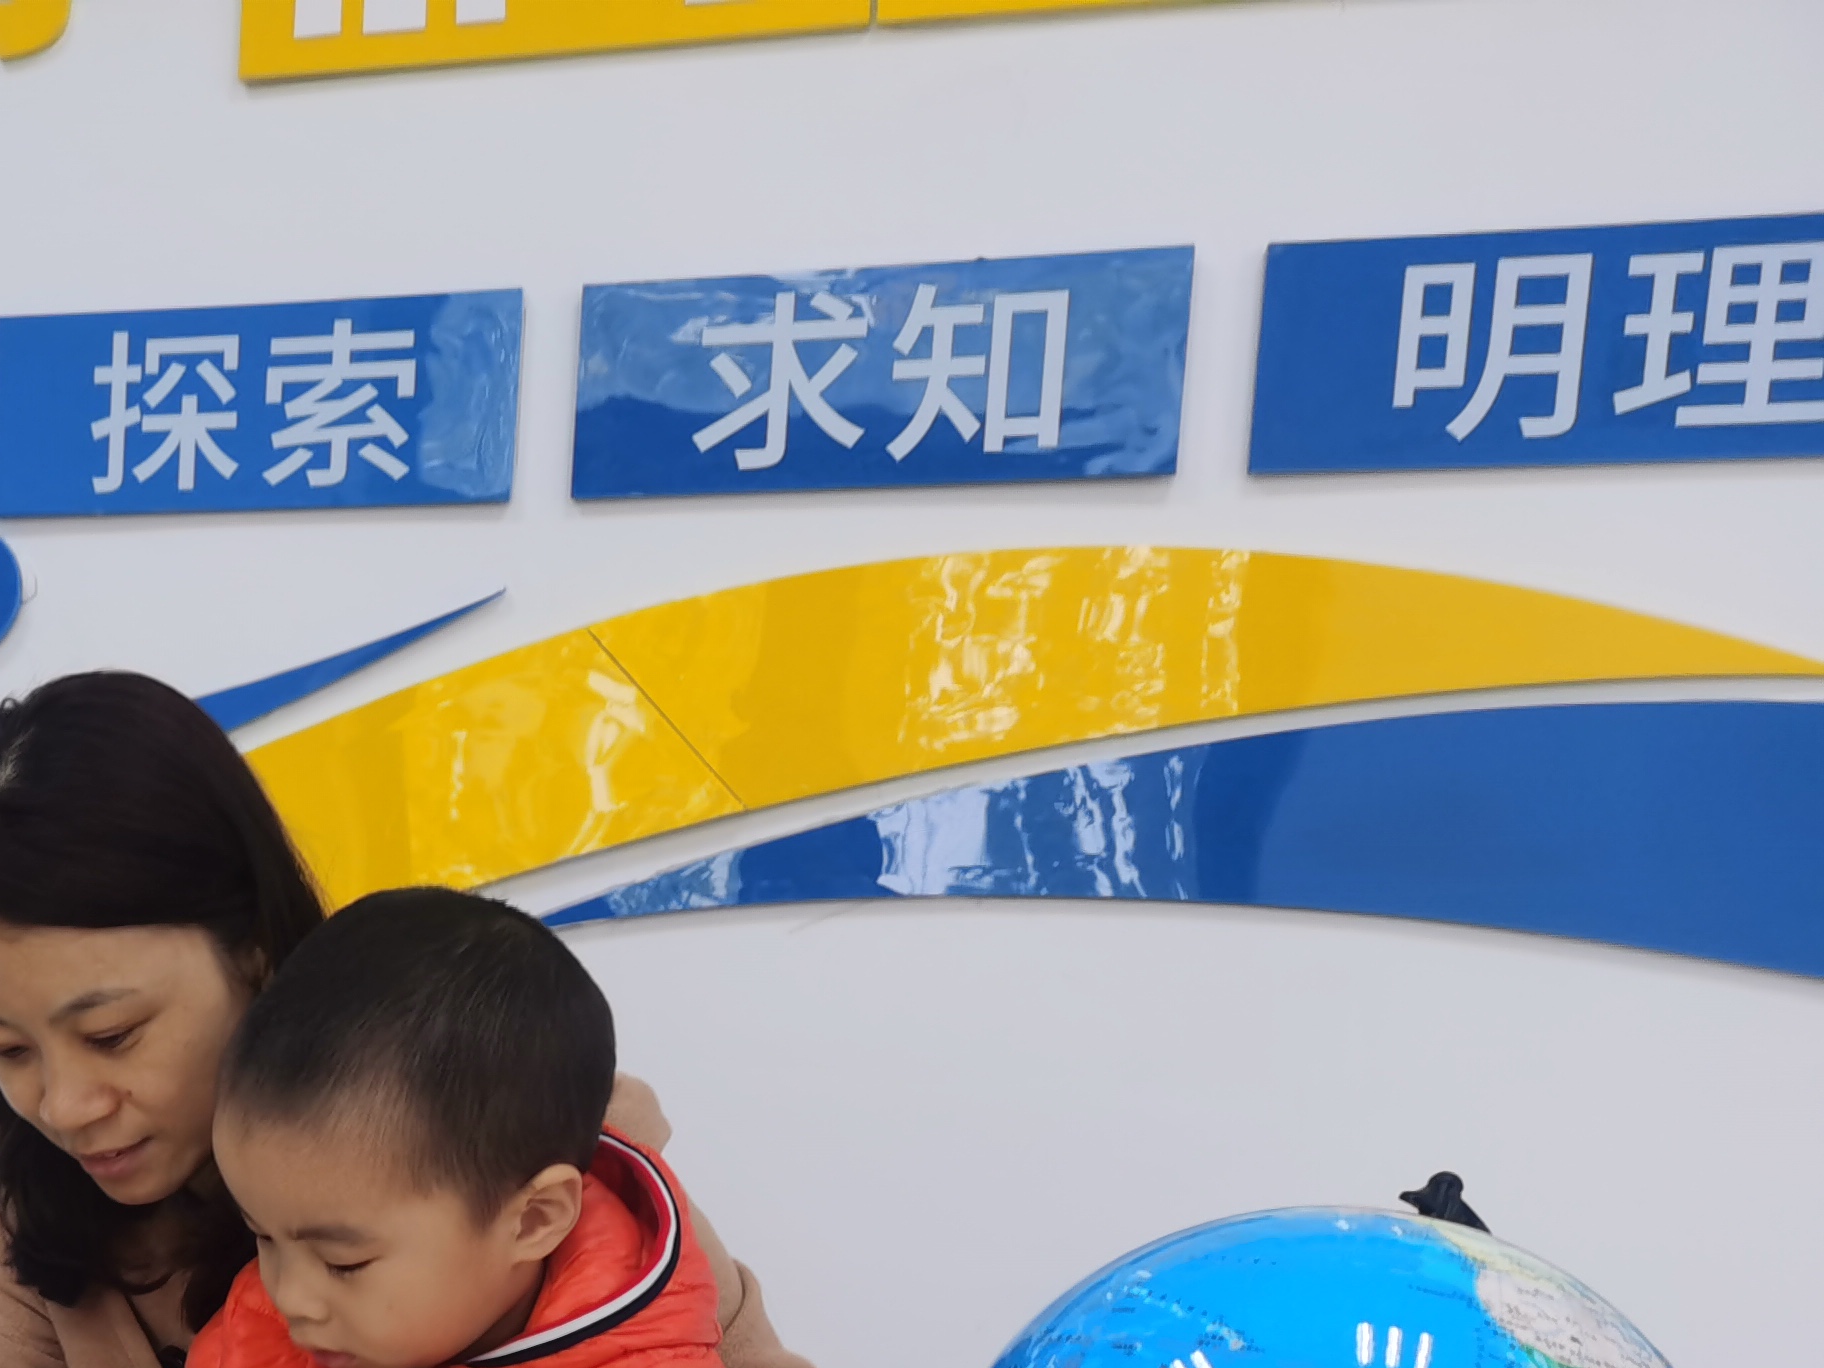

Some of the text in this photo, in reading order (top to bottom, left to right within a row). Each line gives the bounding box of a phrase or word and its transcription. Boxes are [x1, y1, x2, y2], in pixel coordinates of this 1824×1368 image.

[91, 318, 417, 494] 探索
[692, 283, 1070, 471] 求知
[1392, 241, 1824, 442] 明理
